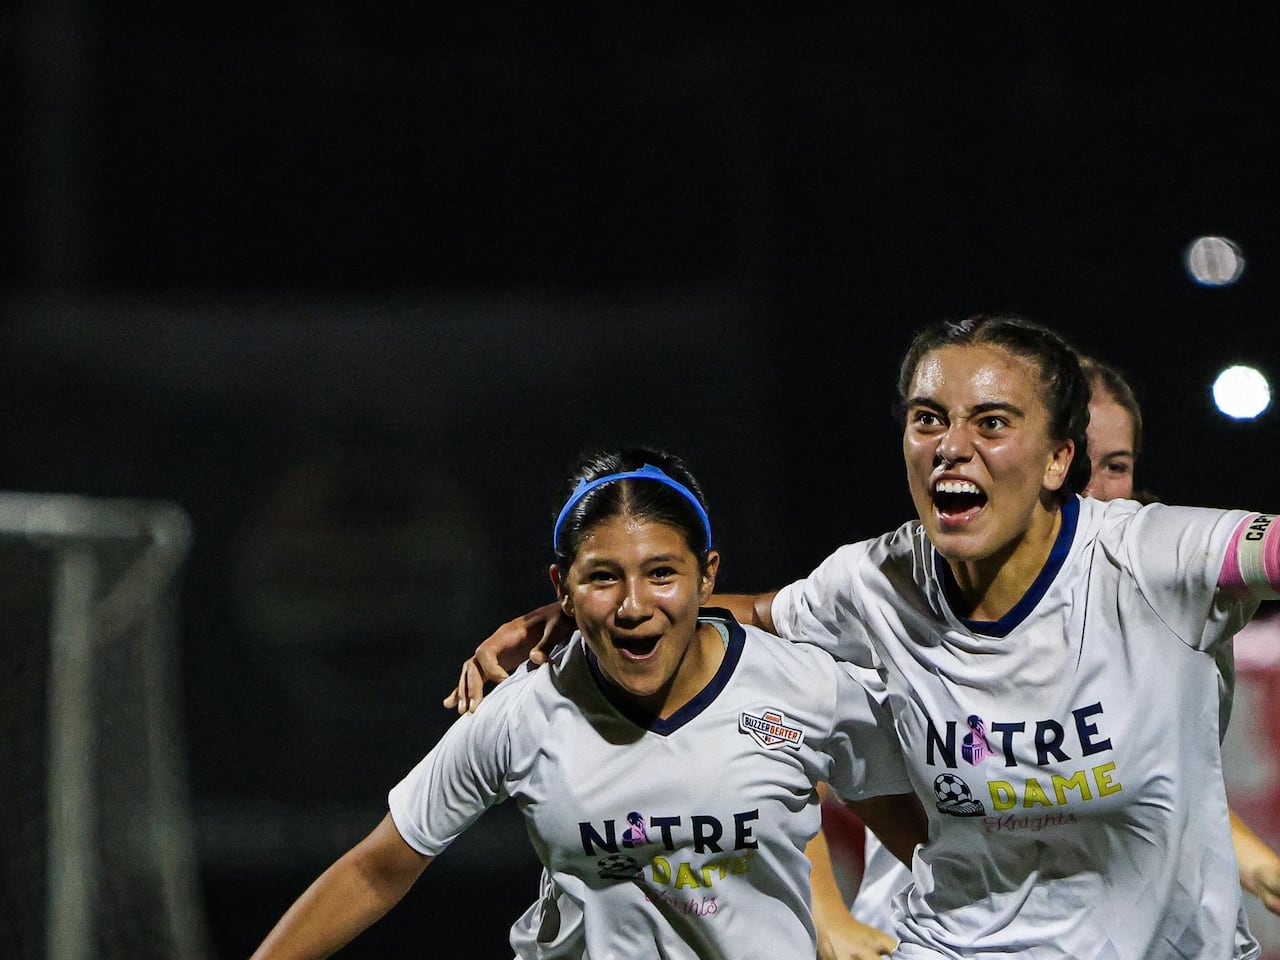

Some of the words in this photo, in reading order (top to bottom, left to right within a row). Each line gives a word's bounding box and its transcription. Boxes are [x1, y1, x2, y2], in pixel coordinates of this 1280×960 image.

[1245, 514, 1272, 541] CAP
[987, 760, 1123, 811] DAME
[651, 852, 757, 890] DAME
